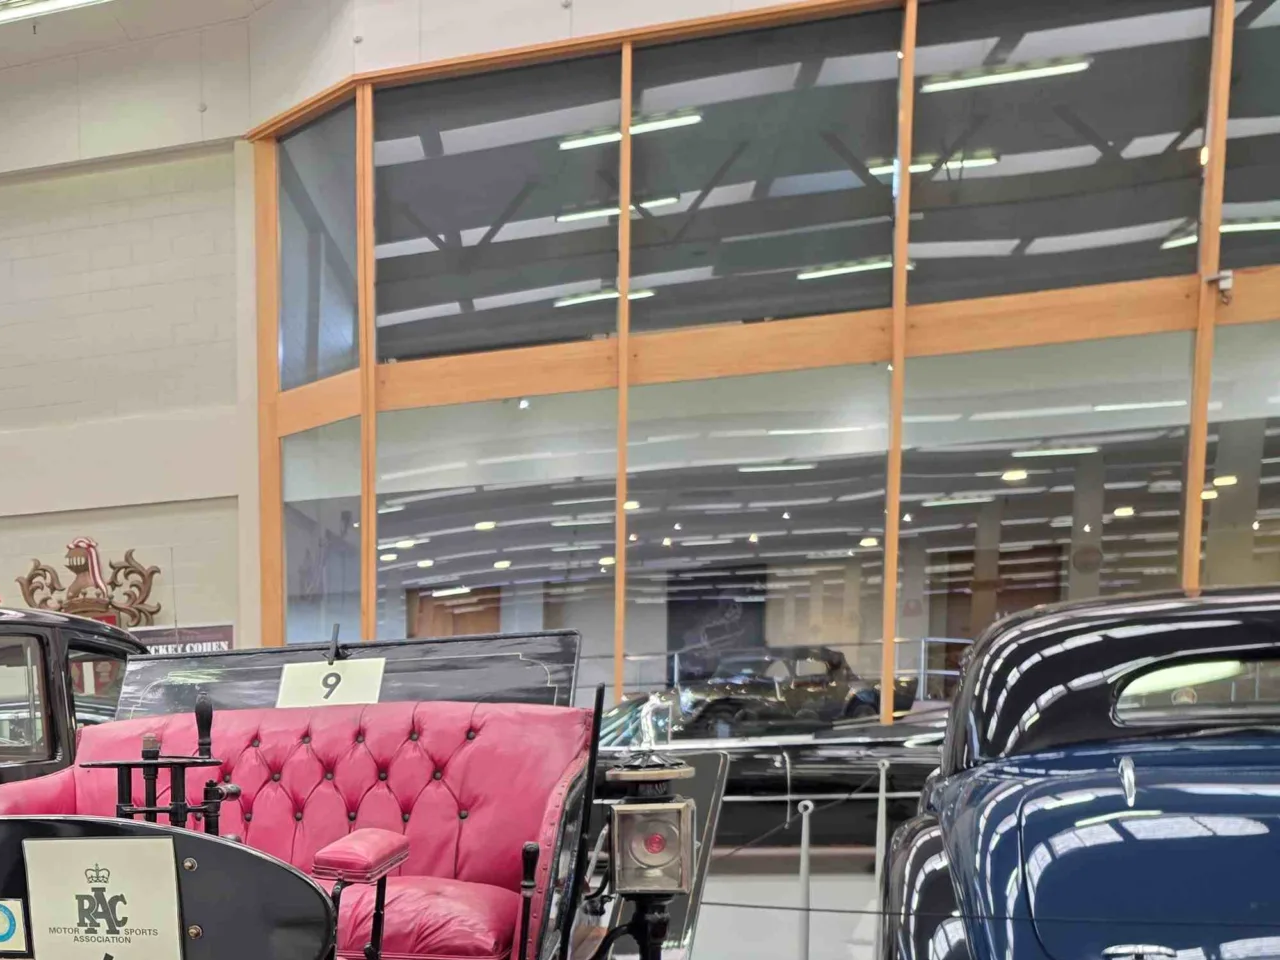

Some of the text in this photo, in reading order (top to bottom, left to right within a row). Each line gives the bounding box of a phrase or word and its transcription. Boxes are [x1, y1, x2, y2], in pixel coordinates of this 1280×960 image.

[322, 672, 341, 700] 9
[75, 887, 128, 935] RAC
[48, 927, 158, 936] MOTOR SPORTS
[73, 935, 131, 944] ASSOCIATION
